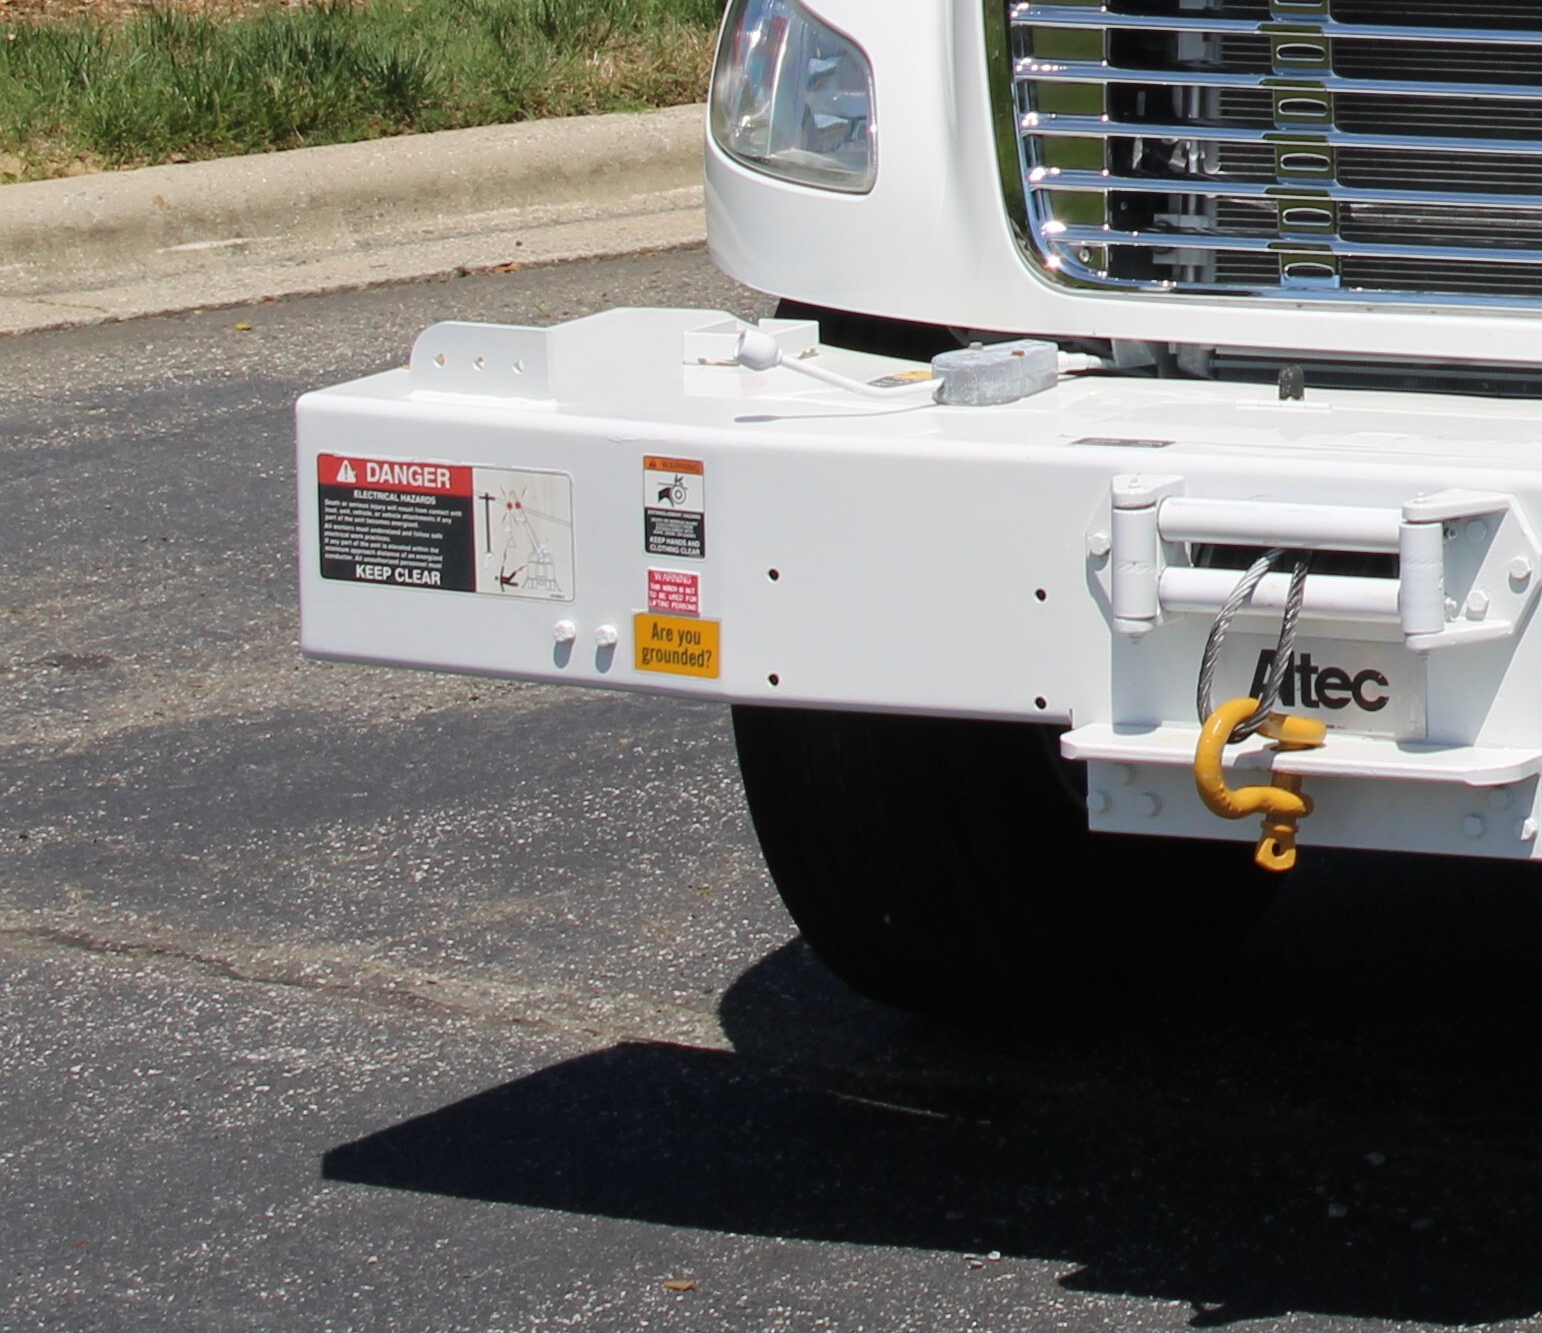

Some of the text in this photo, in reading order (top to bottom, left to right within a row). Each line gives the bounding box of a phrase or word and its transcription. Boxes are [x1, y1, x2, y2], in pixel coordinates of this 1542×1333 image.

[366, 462, 451, 489] DANGER
[353, 489, 436, 505] ELECTRICAL HAZARDS
[355, 564, 441, 585] KEEP CLEAR
[653, 572, 692, 584] WARNING
[651, 622, 701, 647] Are you
[641, 646, 712, 668] grounded?
